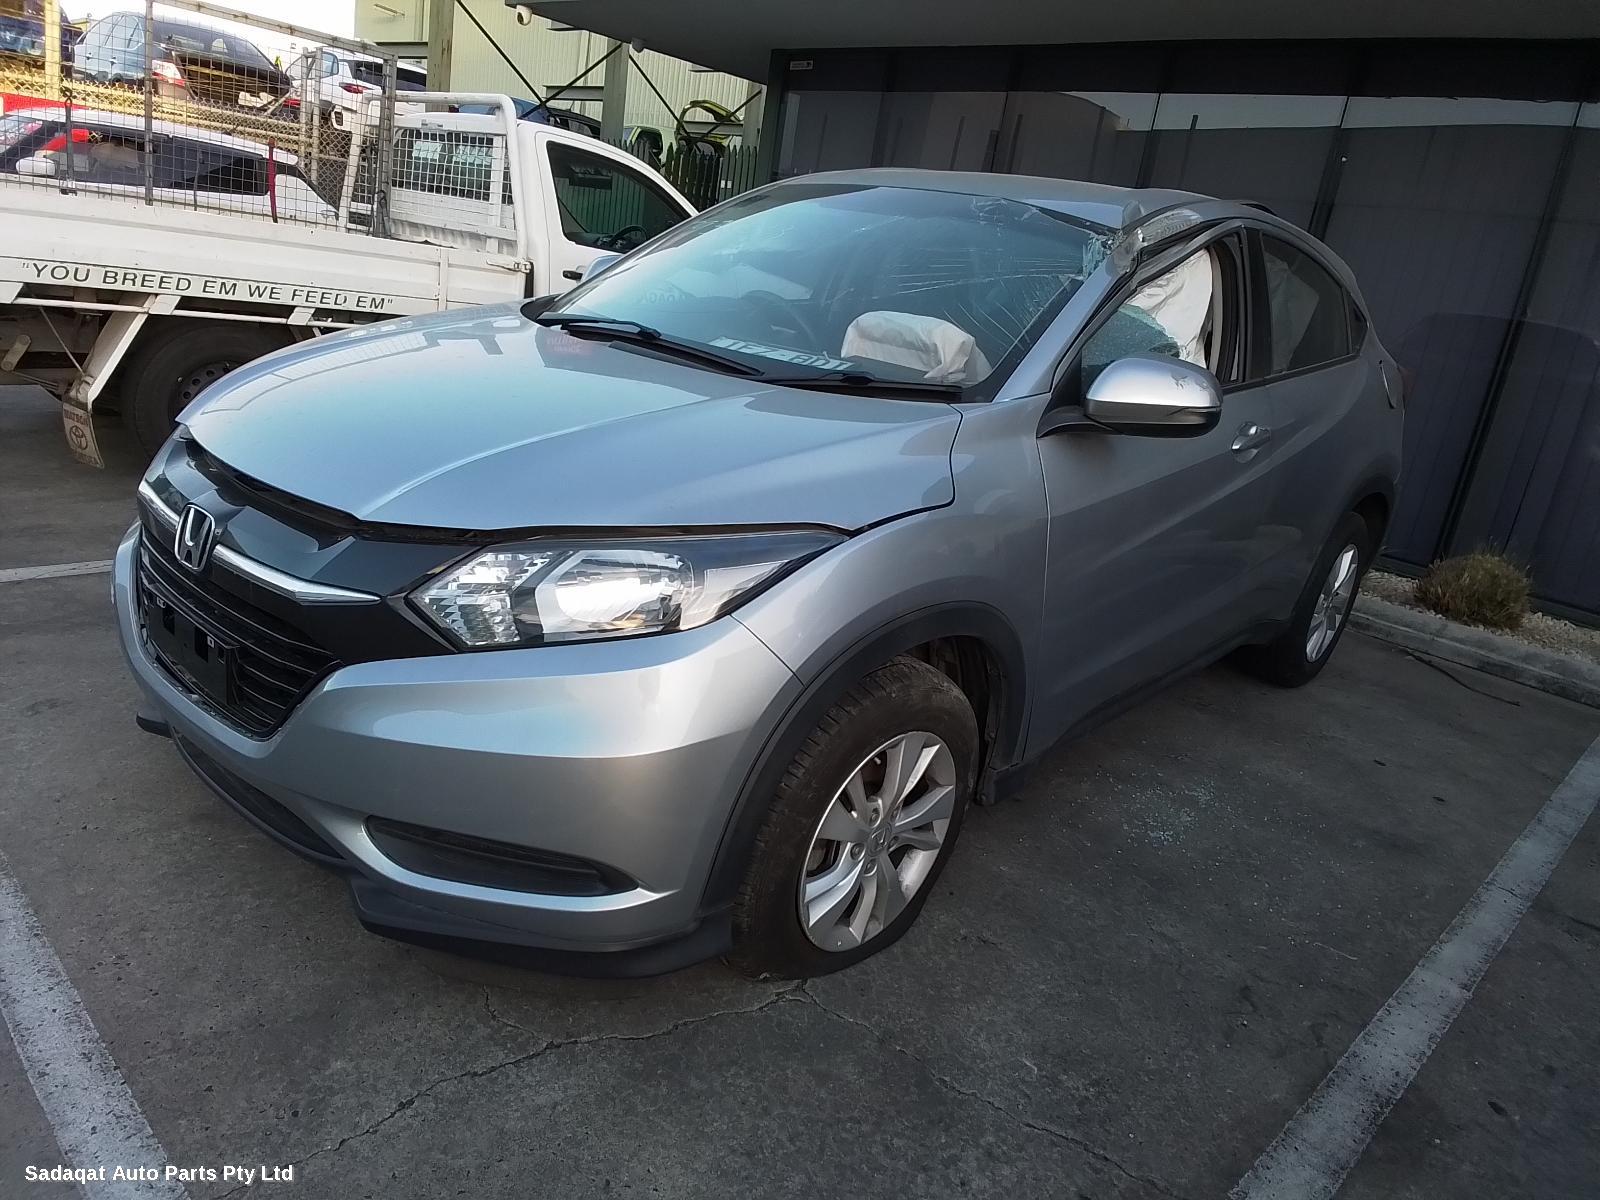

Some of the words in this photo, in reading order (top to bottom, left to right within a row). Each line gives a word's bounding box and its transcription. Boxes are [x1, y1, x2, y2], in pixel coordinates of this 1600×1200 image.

[102, 270, 192, 291] BREED
[202, 279, 238, 296] EM
[248, 284, 283, 300] WE
[291, 288, 348, 306] FEED
